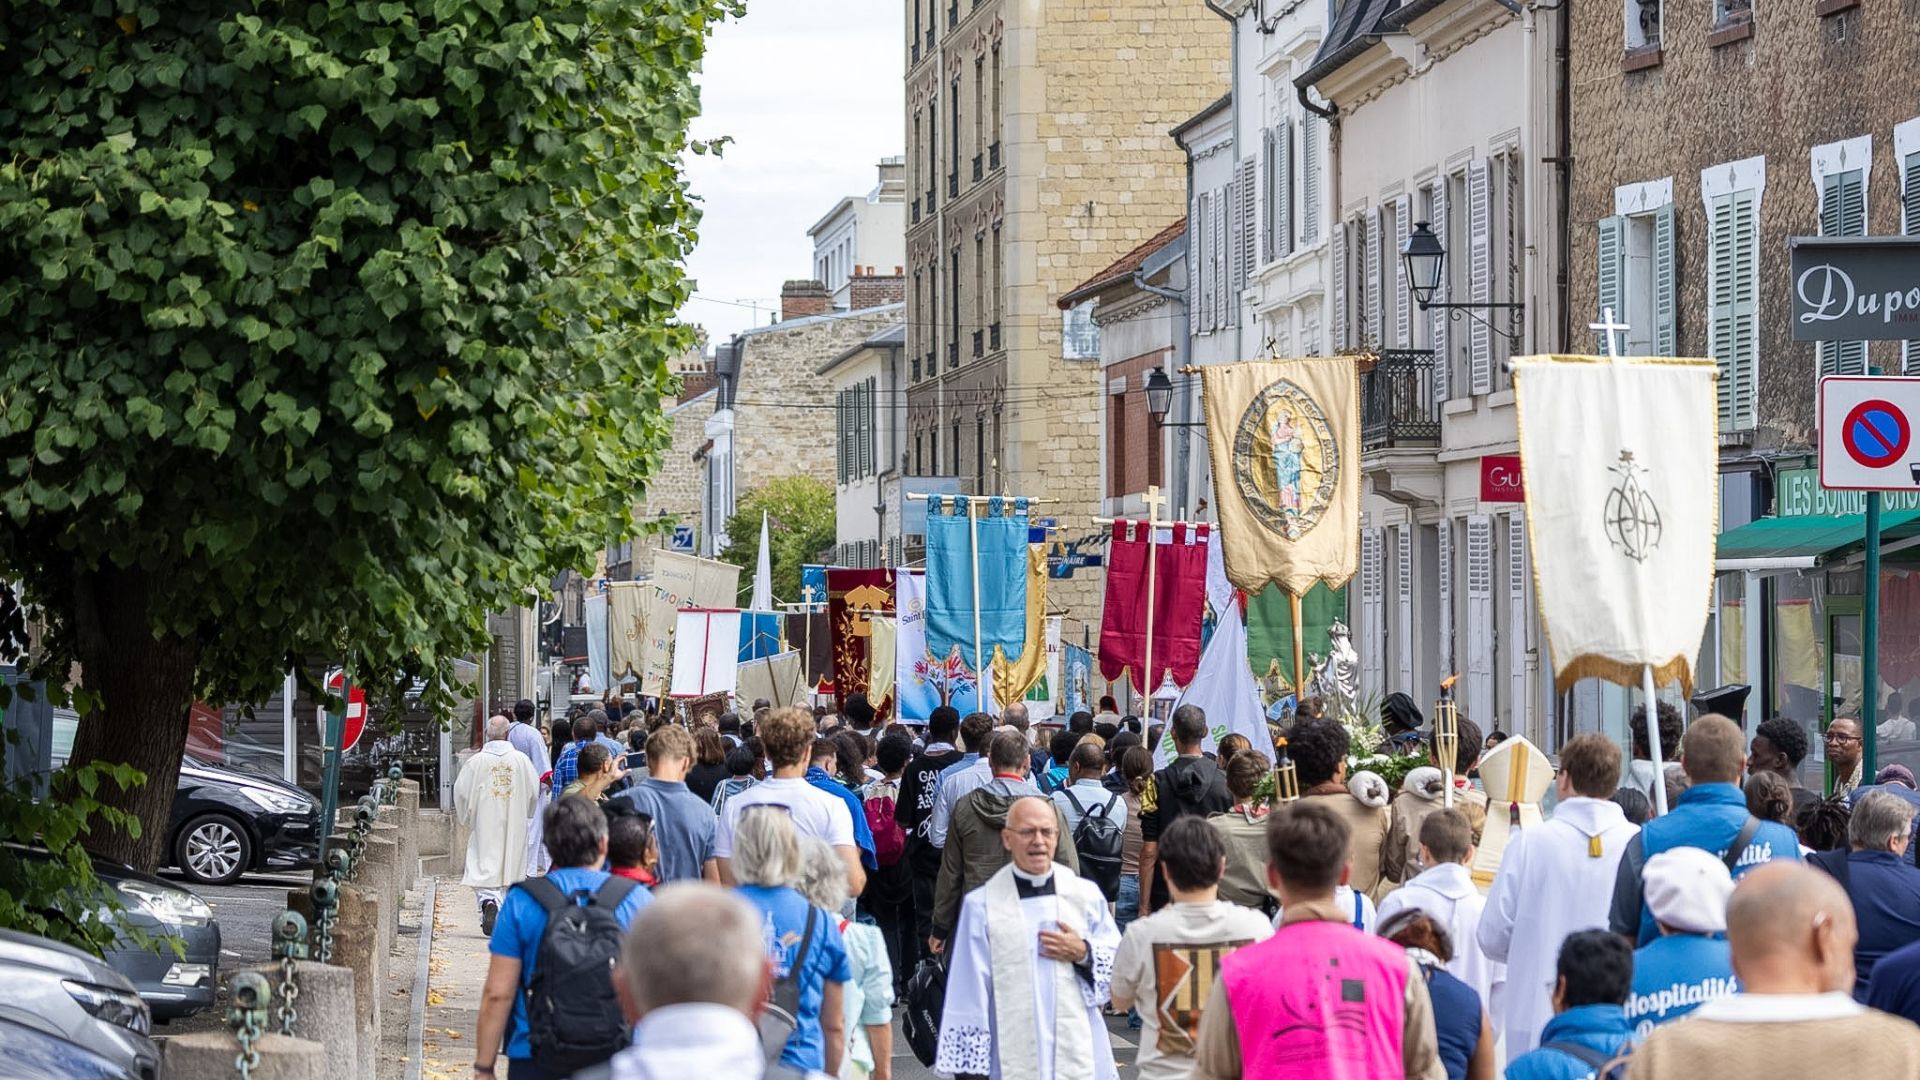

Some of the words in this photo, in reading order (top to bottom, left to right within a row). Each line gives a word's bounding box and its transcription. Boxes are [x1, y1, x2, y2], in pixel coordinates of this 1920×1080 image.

[1797, 263, 1920, 323] Dupo
[1784, 475, 1812, 516] LES
[902, 610, 921, 625] Saint
[1622, 974, 1739, 1019] Hospitalité
